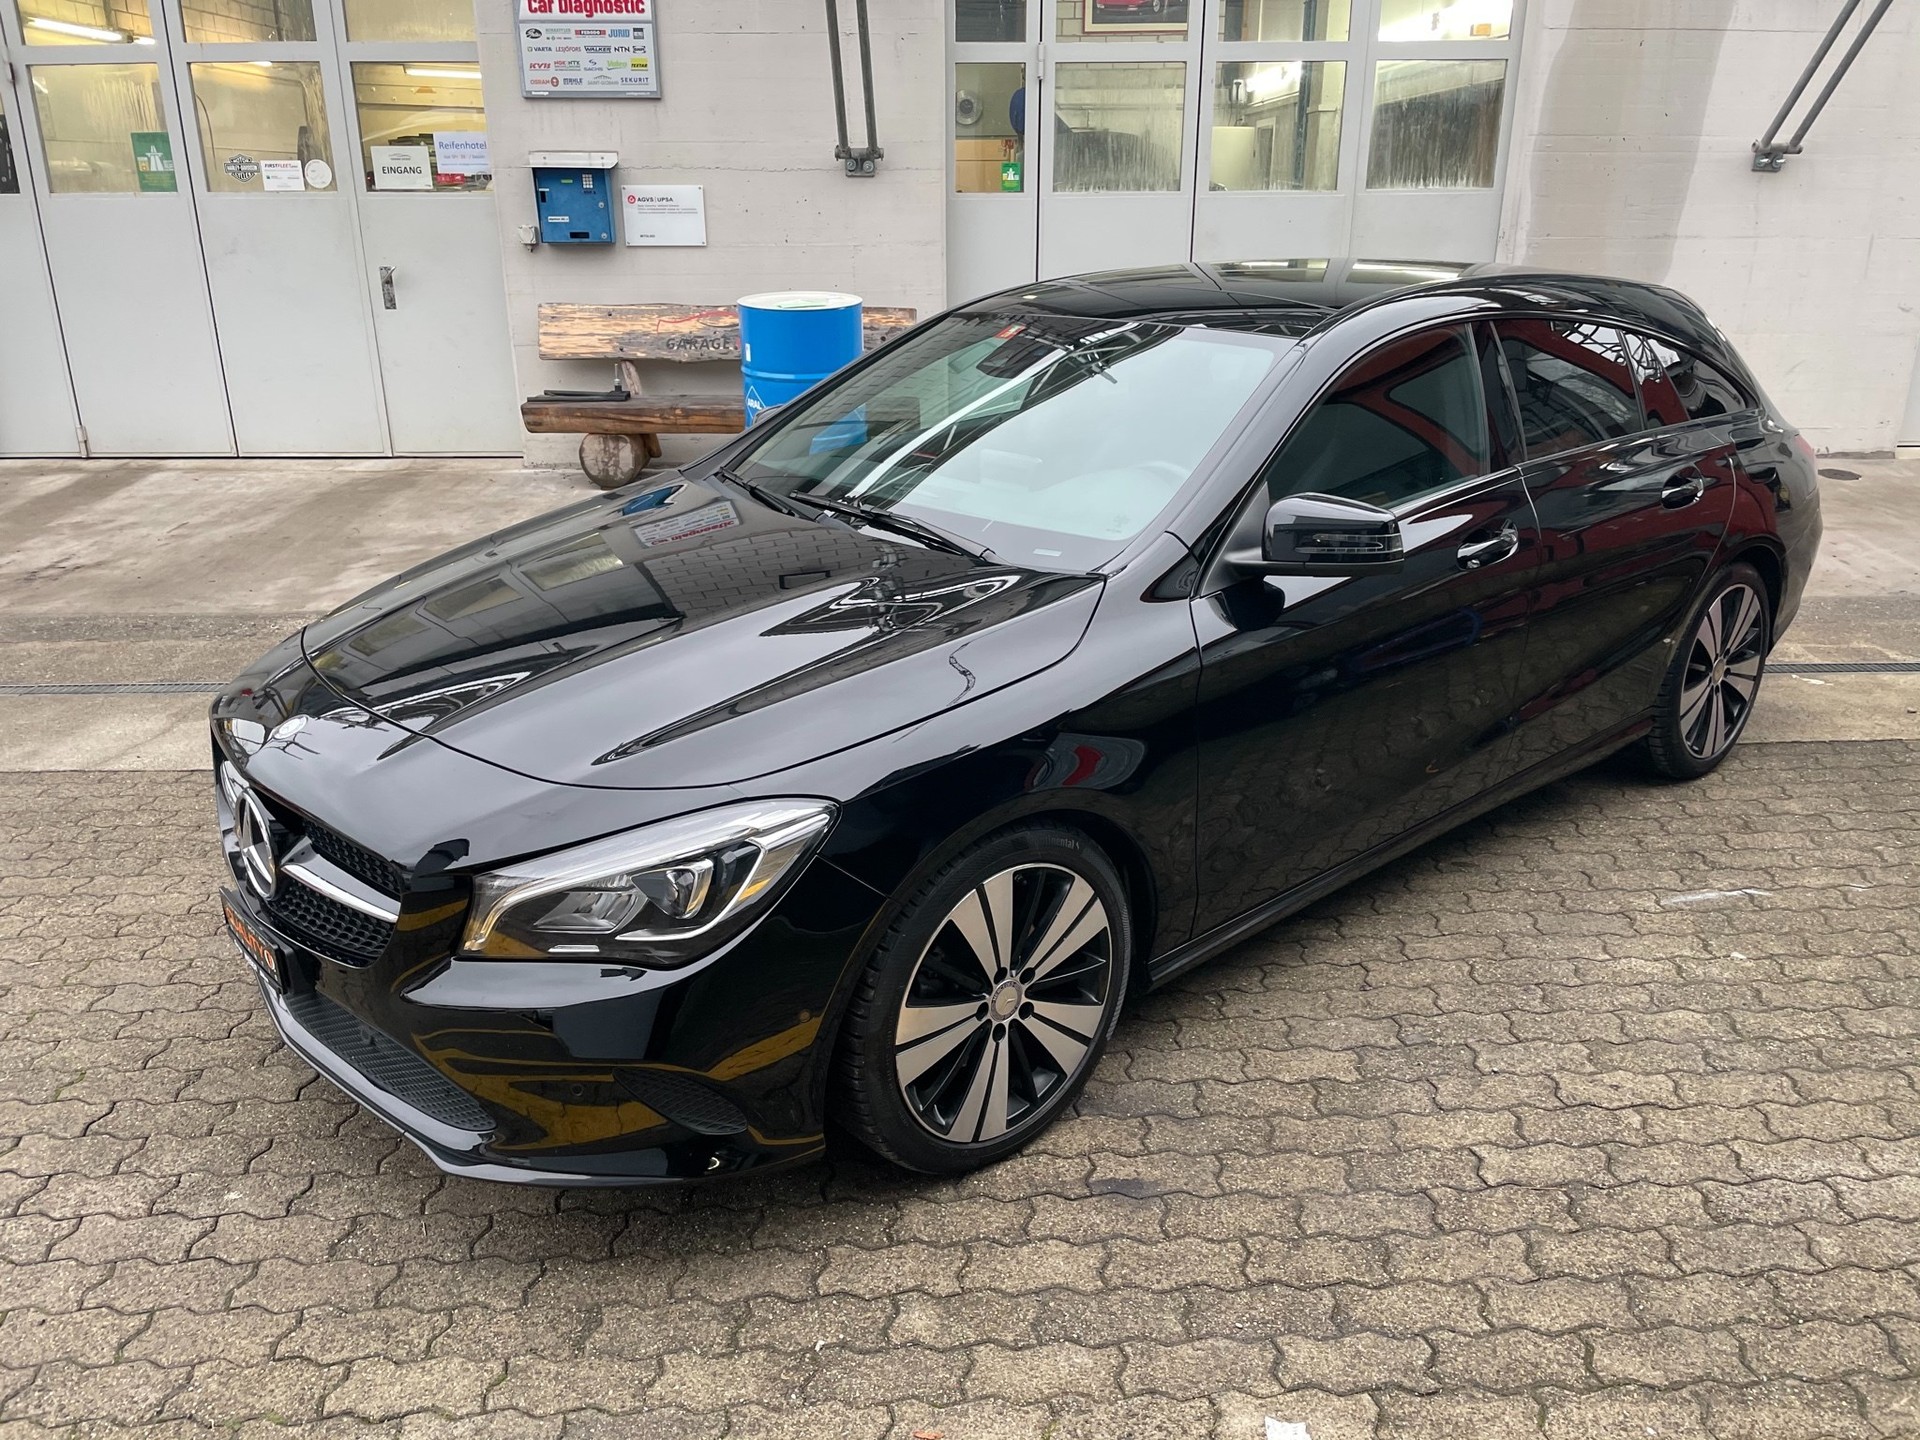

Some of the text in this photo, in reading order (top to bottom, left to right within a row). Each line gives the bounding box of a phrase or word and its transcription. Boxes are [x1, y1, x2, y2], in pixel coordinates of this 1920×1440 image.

[528, 0, 646, 18] Car Diagnostic
[608, 29, 630, 38] JURID
[438, 141, 487, 150] Reifenhotel
[382, 166, 422, 175] EINGANG
[666, 338, 730, 350] GARAGE
[747, 398, 763, 410] ARAL
